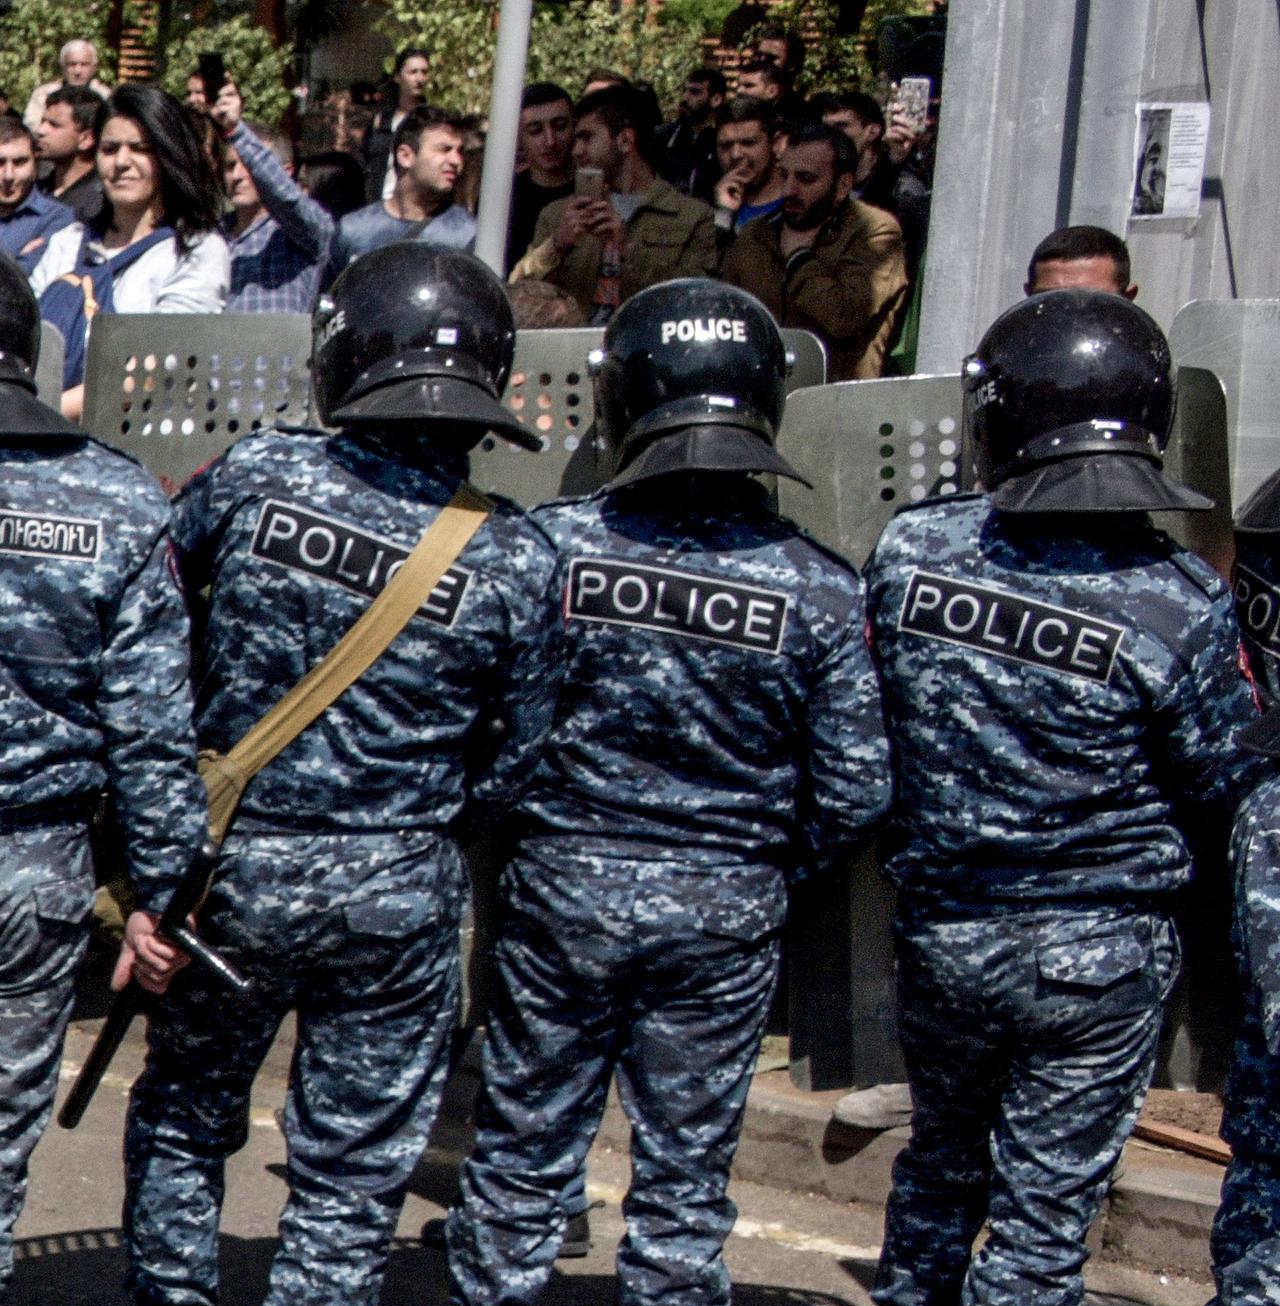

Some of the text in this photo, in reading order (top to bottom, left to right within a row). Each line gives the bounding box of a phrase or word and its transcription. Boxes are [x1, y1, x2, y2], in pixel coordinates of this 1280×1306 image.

[661, 318, 747, 345] POLICE
[576, 570, 776, 641] POLICE
[908, 584, 1108, 671] POLICE
